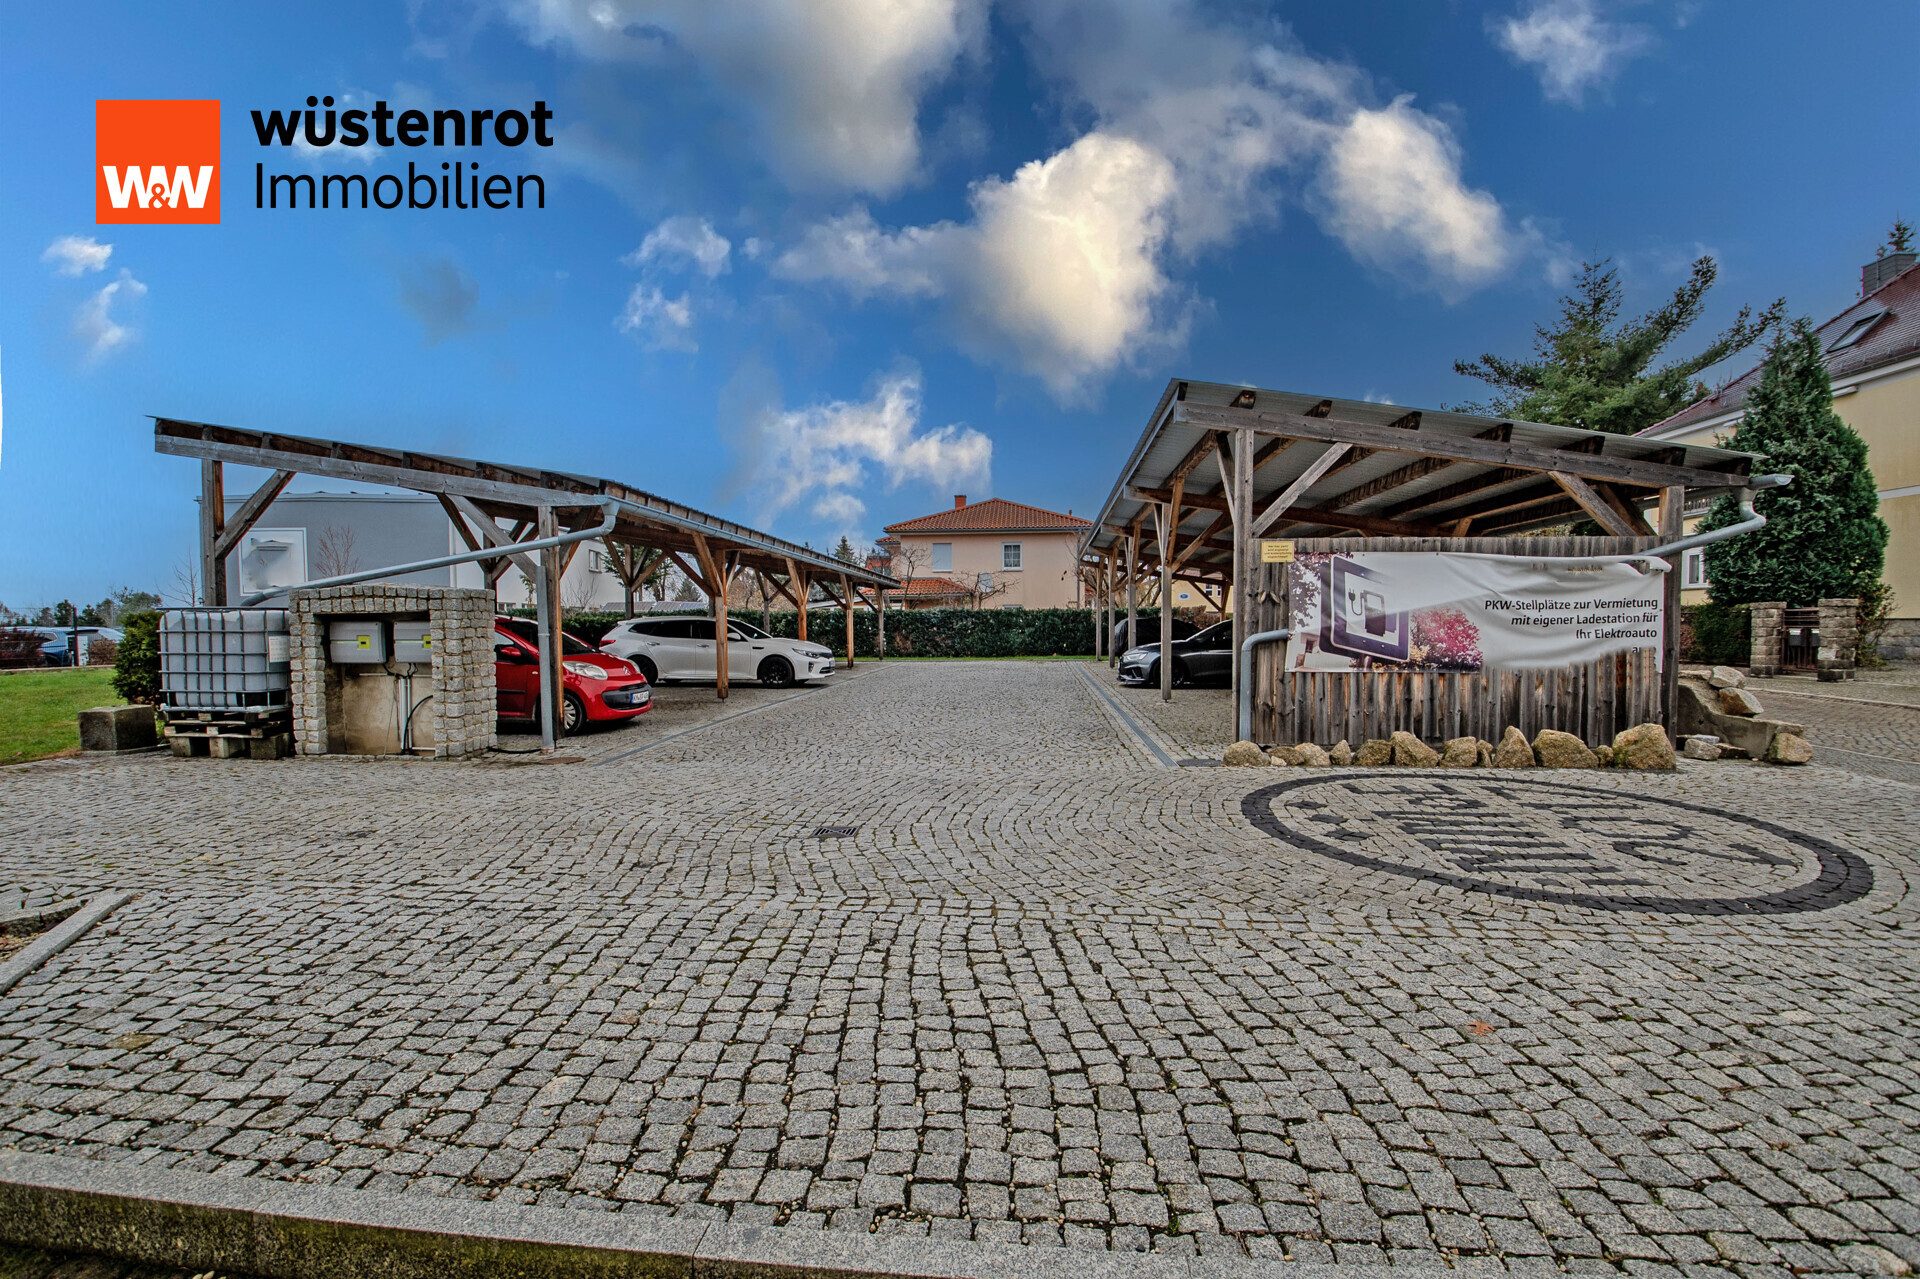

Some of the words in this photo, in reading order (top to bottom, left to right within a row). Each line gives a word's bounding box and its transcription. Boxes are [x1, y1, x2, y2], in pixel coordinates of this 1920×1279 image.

[1484, 599, 1571, 613] PKW-Stellplätze
[1573, 601, 1592, 610] zur
[1593, 598, 1658, 610] Vermietung
[1511, 615, 1531, 625] mit
[1533, 615, 1574, 628] eigener
[1576, 613, 1640, 625] Ladestation
[1642, 612, 1658, 623] für
[1576, 628, 1592, 639] Ihr
[1595, 628, 1658, 639] Elektroauto
